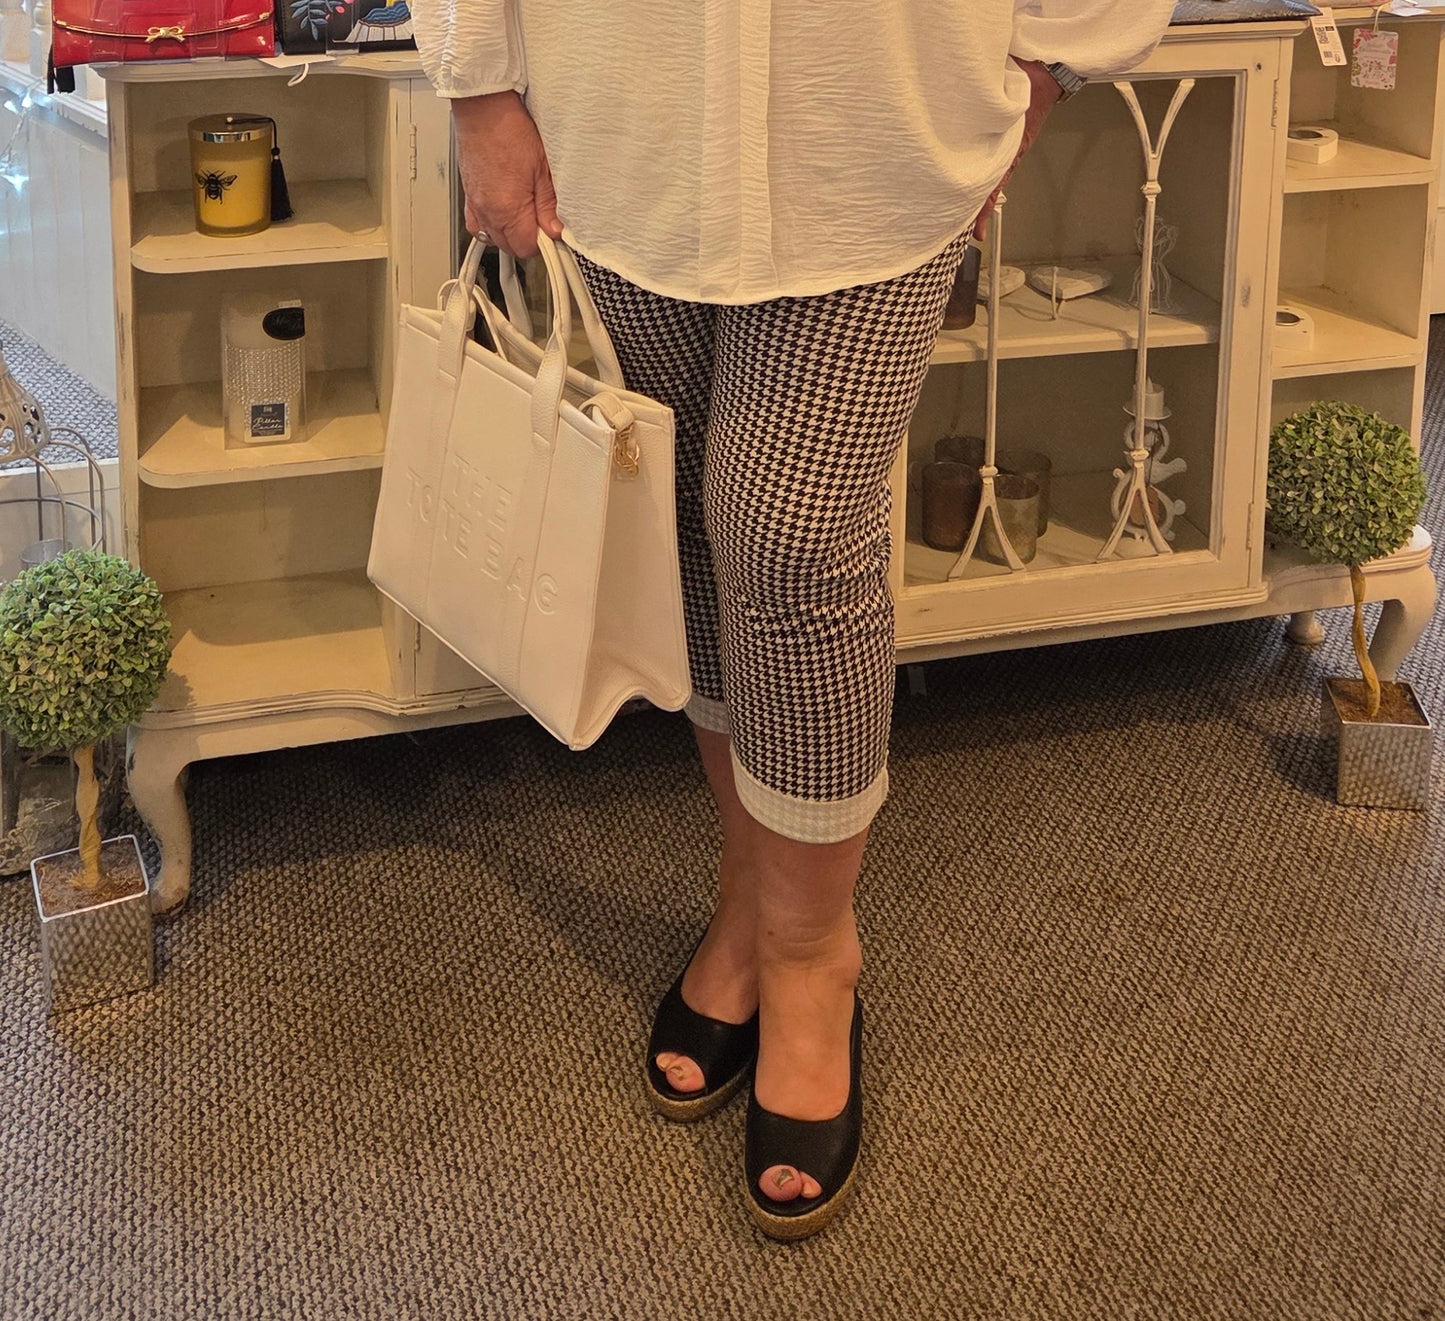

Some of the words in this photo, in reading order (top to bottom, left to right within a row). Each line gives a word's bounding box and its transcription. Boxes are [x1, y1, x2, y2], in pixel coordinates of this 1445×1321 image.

[406, 466, 473, 560] TOTE
[480, 534, 559, 616] BAG
[452, 452, 513, 532] THE
